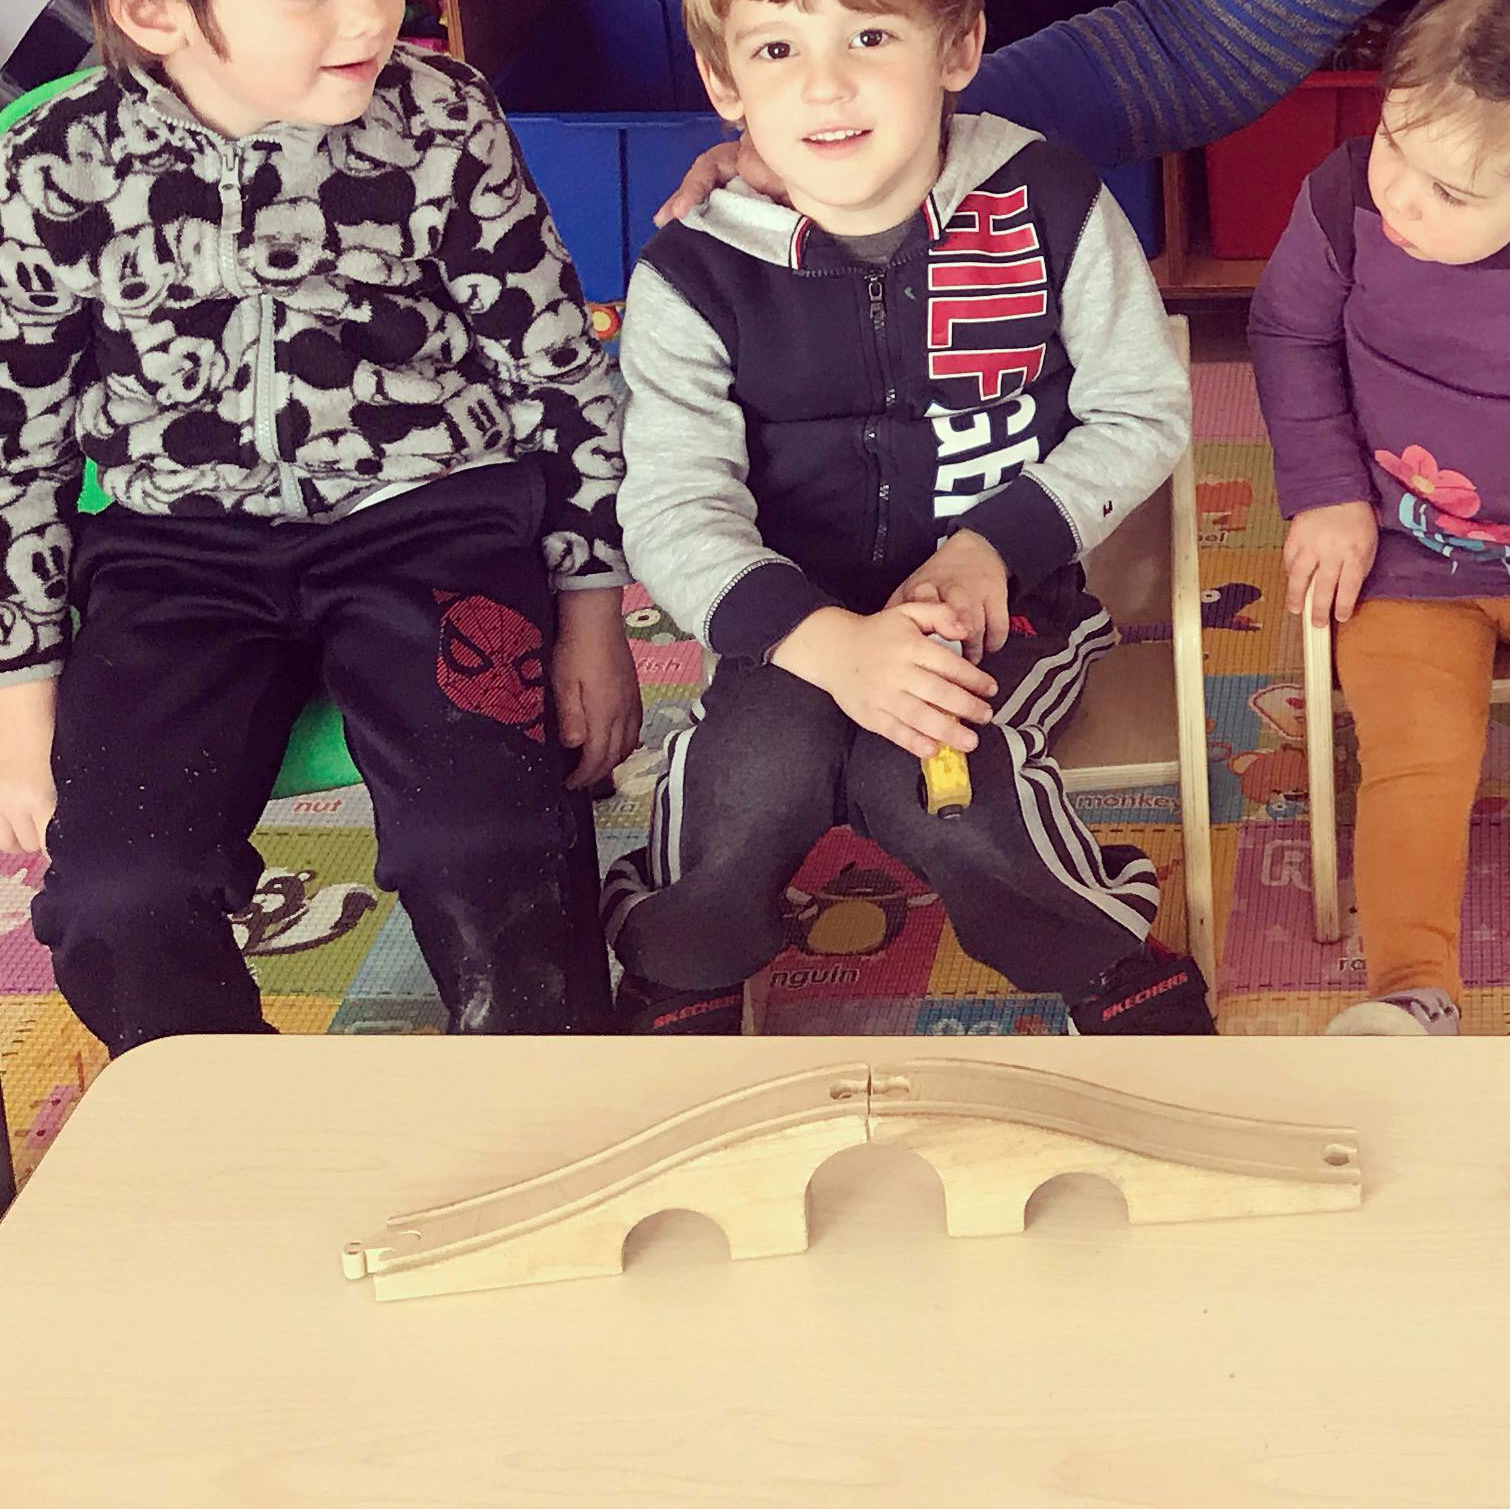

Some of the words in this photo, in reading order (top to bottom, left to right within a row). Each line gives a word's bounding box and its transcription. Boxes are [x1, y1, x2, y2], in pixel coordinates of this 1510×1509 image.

[1077, 792, 1182, 812] monkey
[769, 964, 860, 989] nguin
[1102, 971, 1189, 1022] SKECHERS
